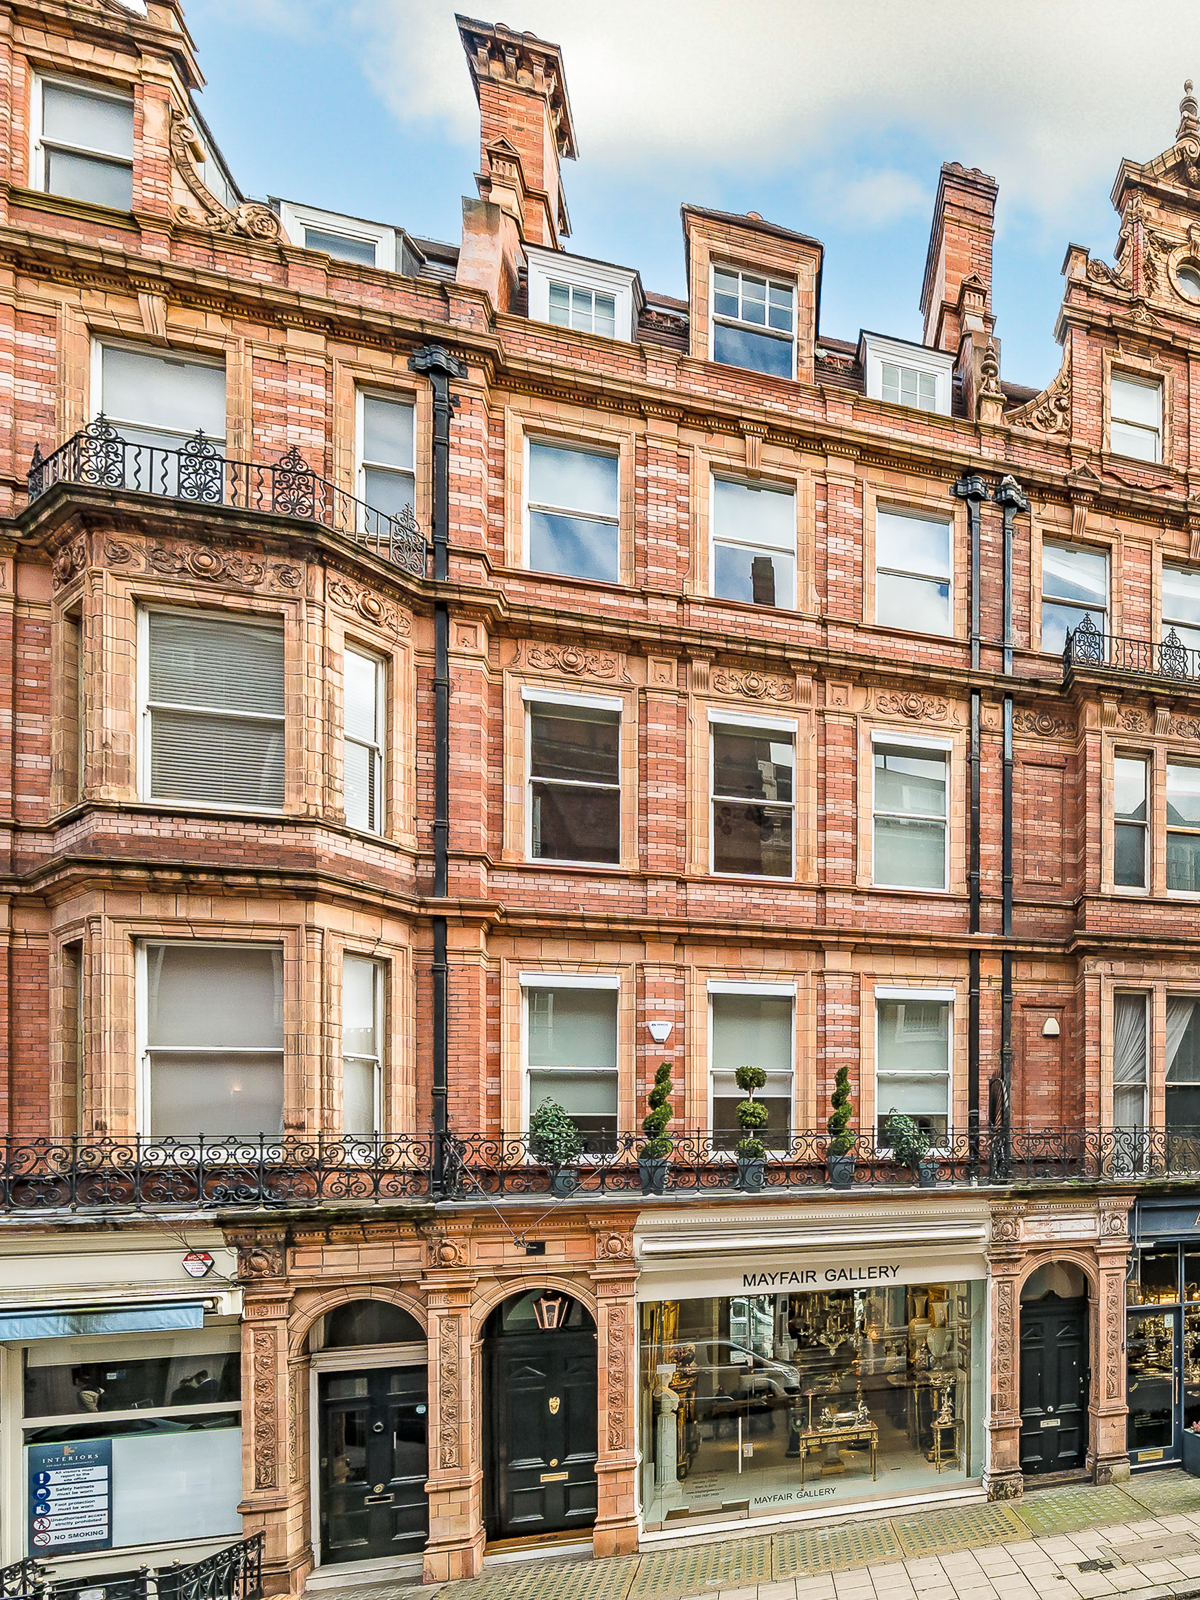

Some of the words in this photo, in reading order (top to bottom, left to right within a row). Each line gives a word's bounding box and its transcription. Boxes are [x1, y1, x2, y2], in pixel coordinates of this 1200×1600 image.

[743, 1270, 817, 1287] MAYFAIR
[824, 1265, 900, 1282] GALLERY
[42, 1453, 99, 1464] INTERIORS
[753, 1493, 793, 1505] MAYFAIR
[796, 1487, 837, 1499] GALLERY
[51, 1514, 87, 1522] Unauthorised
[75, 1517, 102, 1525] prohibited
[67, 1529, 104, 1539] SMOKING
